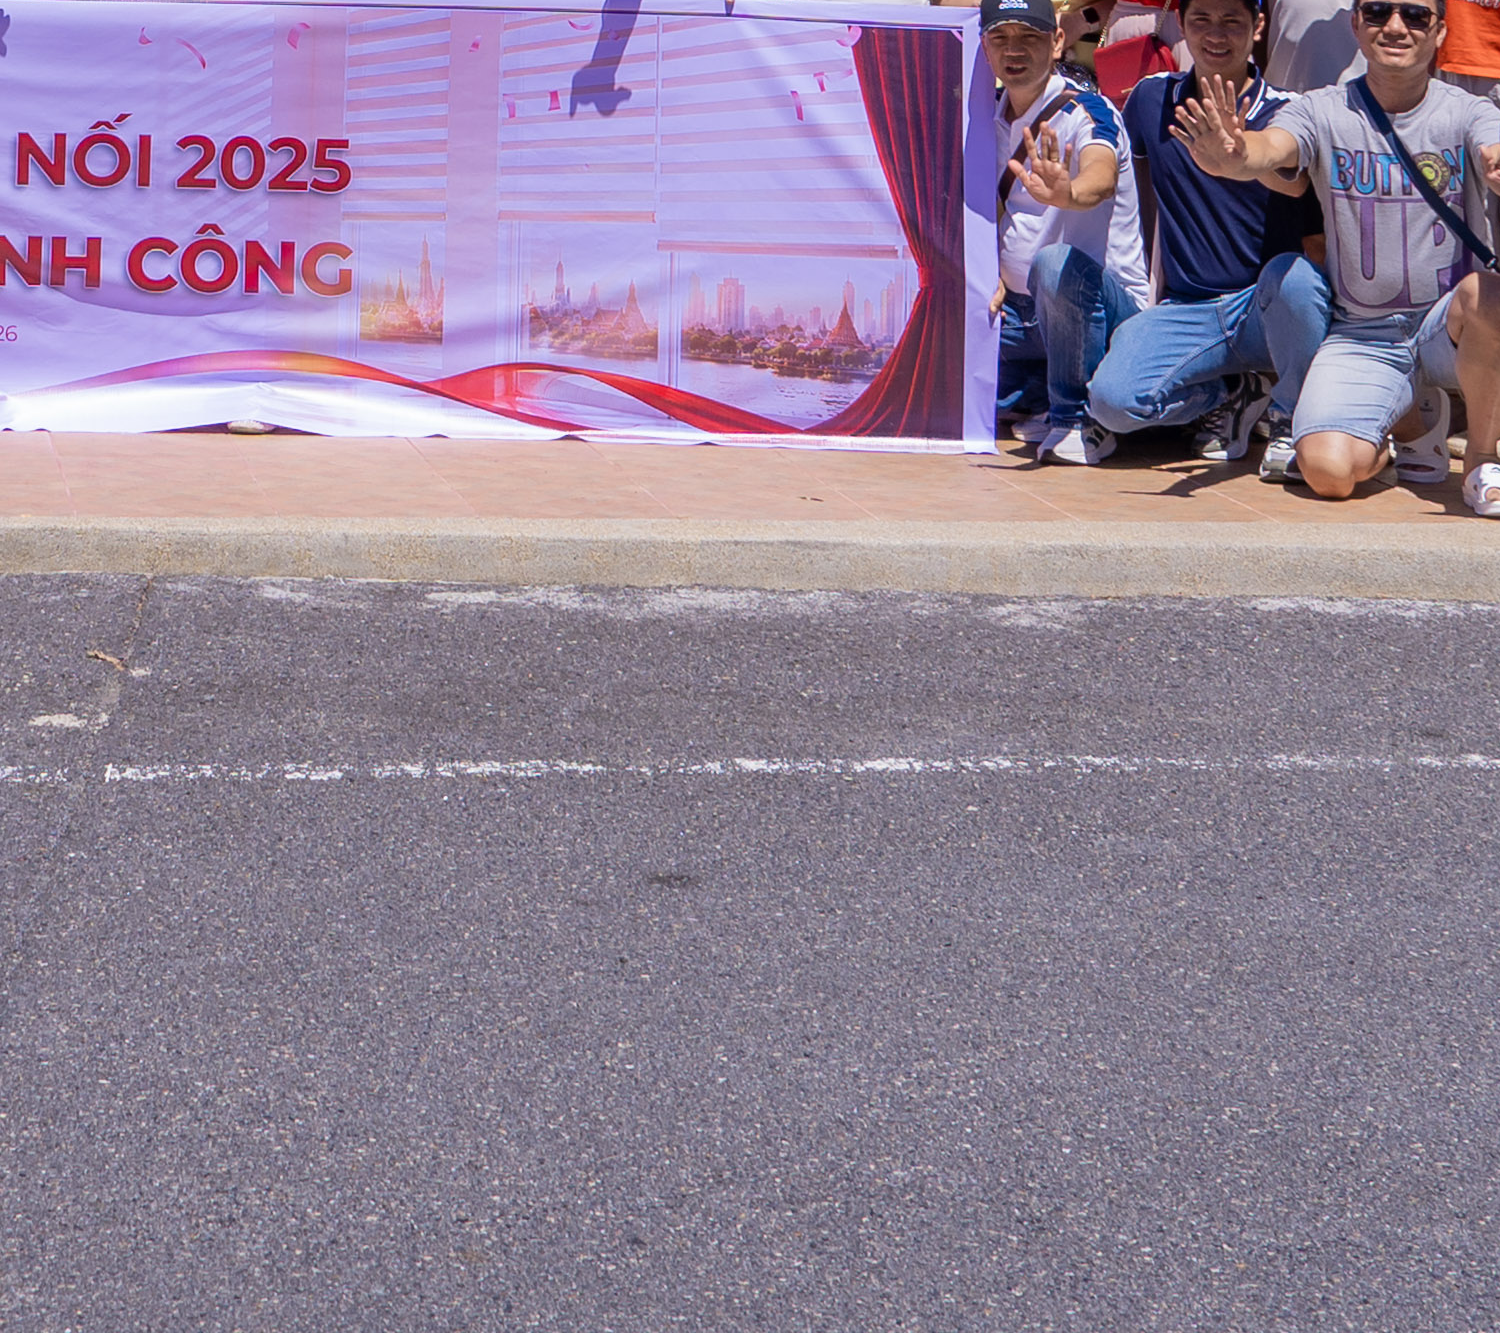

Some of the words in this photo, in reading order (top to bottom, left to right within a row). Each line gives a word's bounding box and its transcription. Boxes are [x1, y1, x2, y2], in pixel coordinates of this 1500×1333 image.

[998, 1, 1029, 10] adidas
[15, 113, 152, 187] NỐI
[175, 134, 353, 193] 2025
[127, 223, 354, 298] CÔNG
